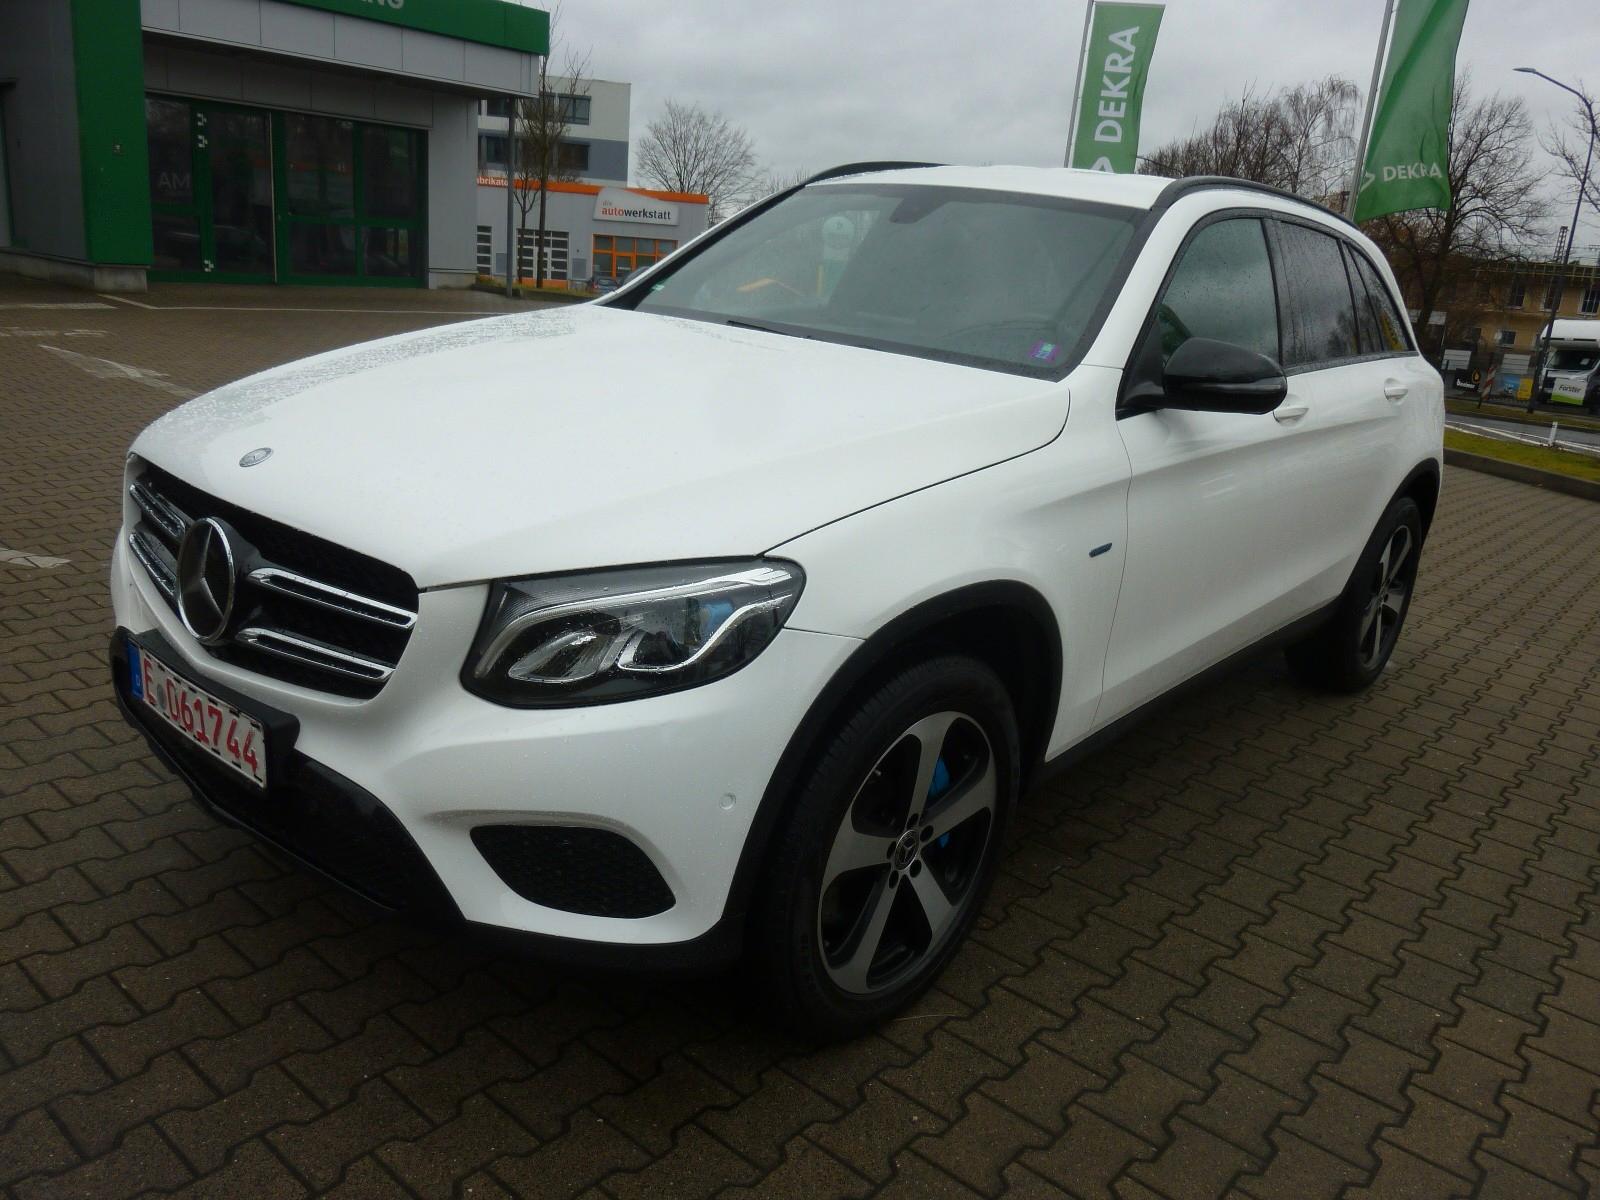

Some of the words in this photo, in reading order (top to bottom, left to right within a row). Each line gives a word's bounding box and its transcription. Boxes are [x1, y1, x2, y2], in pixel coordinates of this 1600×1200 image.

[1094, 26, 1140, 143] DEKRA
[1383, 162, 1442, 181] DEKRA
[602, 207, 671, 220] autowerkstatt
[144, 658, 156, 706] E
